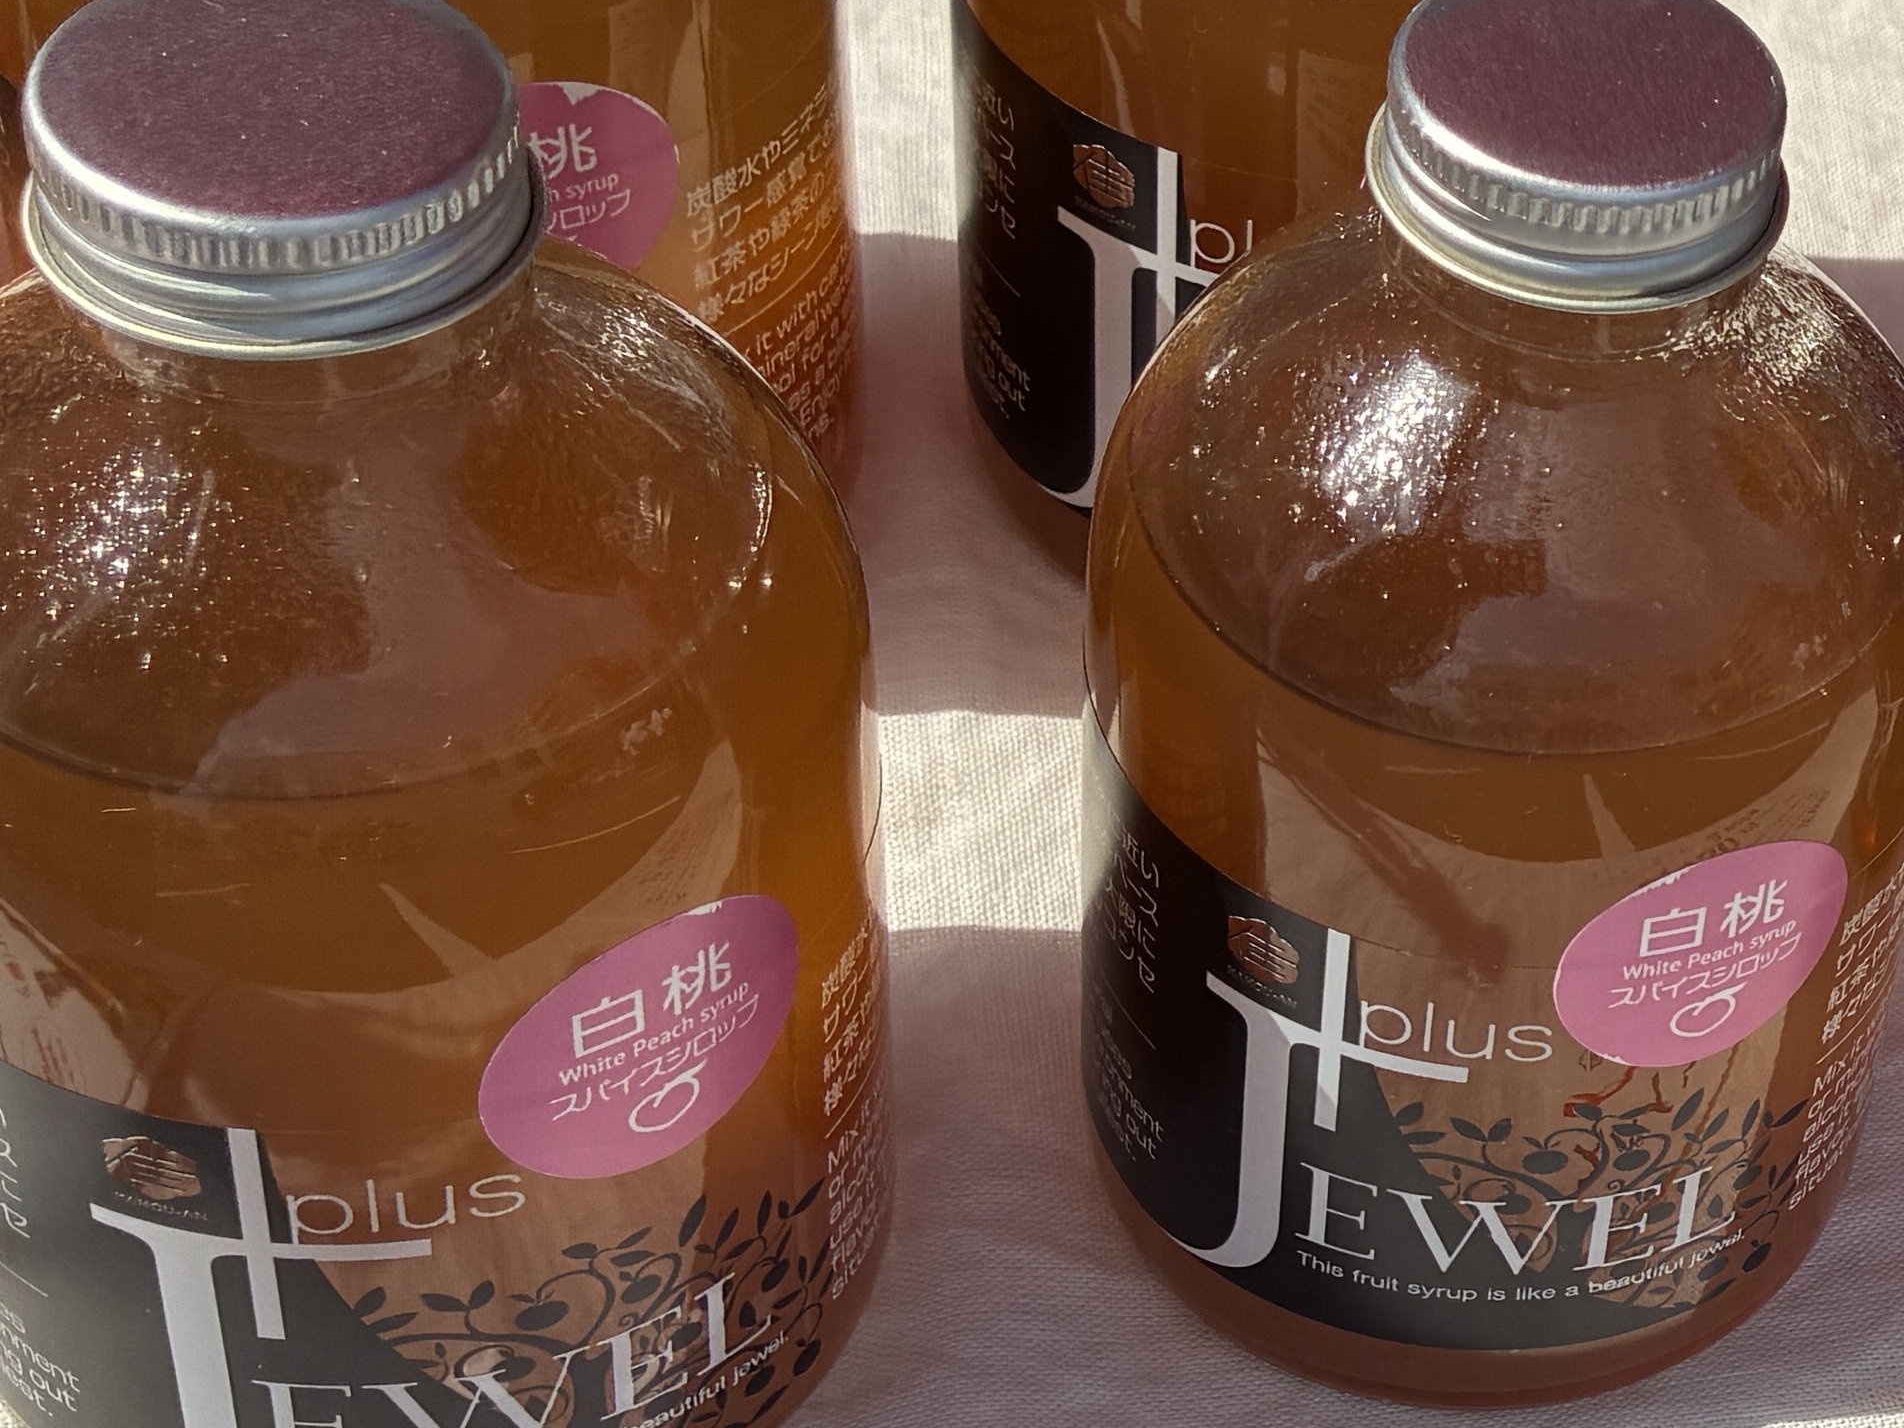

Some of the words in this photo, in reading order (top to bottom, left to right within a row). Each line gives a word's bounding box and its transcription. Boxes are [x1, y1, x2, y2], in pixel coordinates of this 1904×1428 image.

[528, 124, 597, 179] 桃
[566, 173, 619, 199] syrup
[1191, 216, 1253, 266] pl
[776, 290, 818, 341] with
[1623, 959, 1682, 981] White
[1687, 940, 1744, 970] Peach
[1748, 919, 1798, 950] syrup
[1639, 879, 1789, 958] 白桃
[571, 939, 732, 1059] 白桃
[1608, 932, 1803, 1009] スパイスシロップ
[548, 993, 760, 1122] スパイスシロップ
[558, 1052, 627, 1087] White
[632, 1016, 695, 1058] Peach
[699, 981, 750, 1025] syrup
[1358, 995, 1555, 1063] plus
[290, 1169, 528, 1239] plus
[1296, 1249, 1344, 1278] This
[1352, 1267, 1399, 1293] fruit
[1407, 1282, 1478, 1303] syrup
[1487, 1287, 1506, 1302] is
[1516, 1285, 1556, 1302] like
[1564, 1284, 1580, 1297] a
[1589, 1259, 1685, 1294] beautiful
[28, 1366, 78, 1412] out
